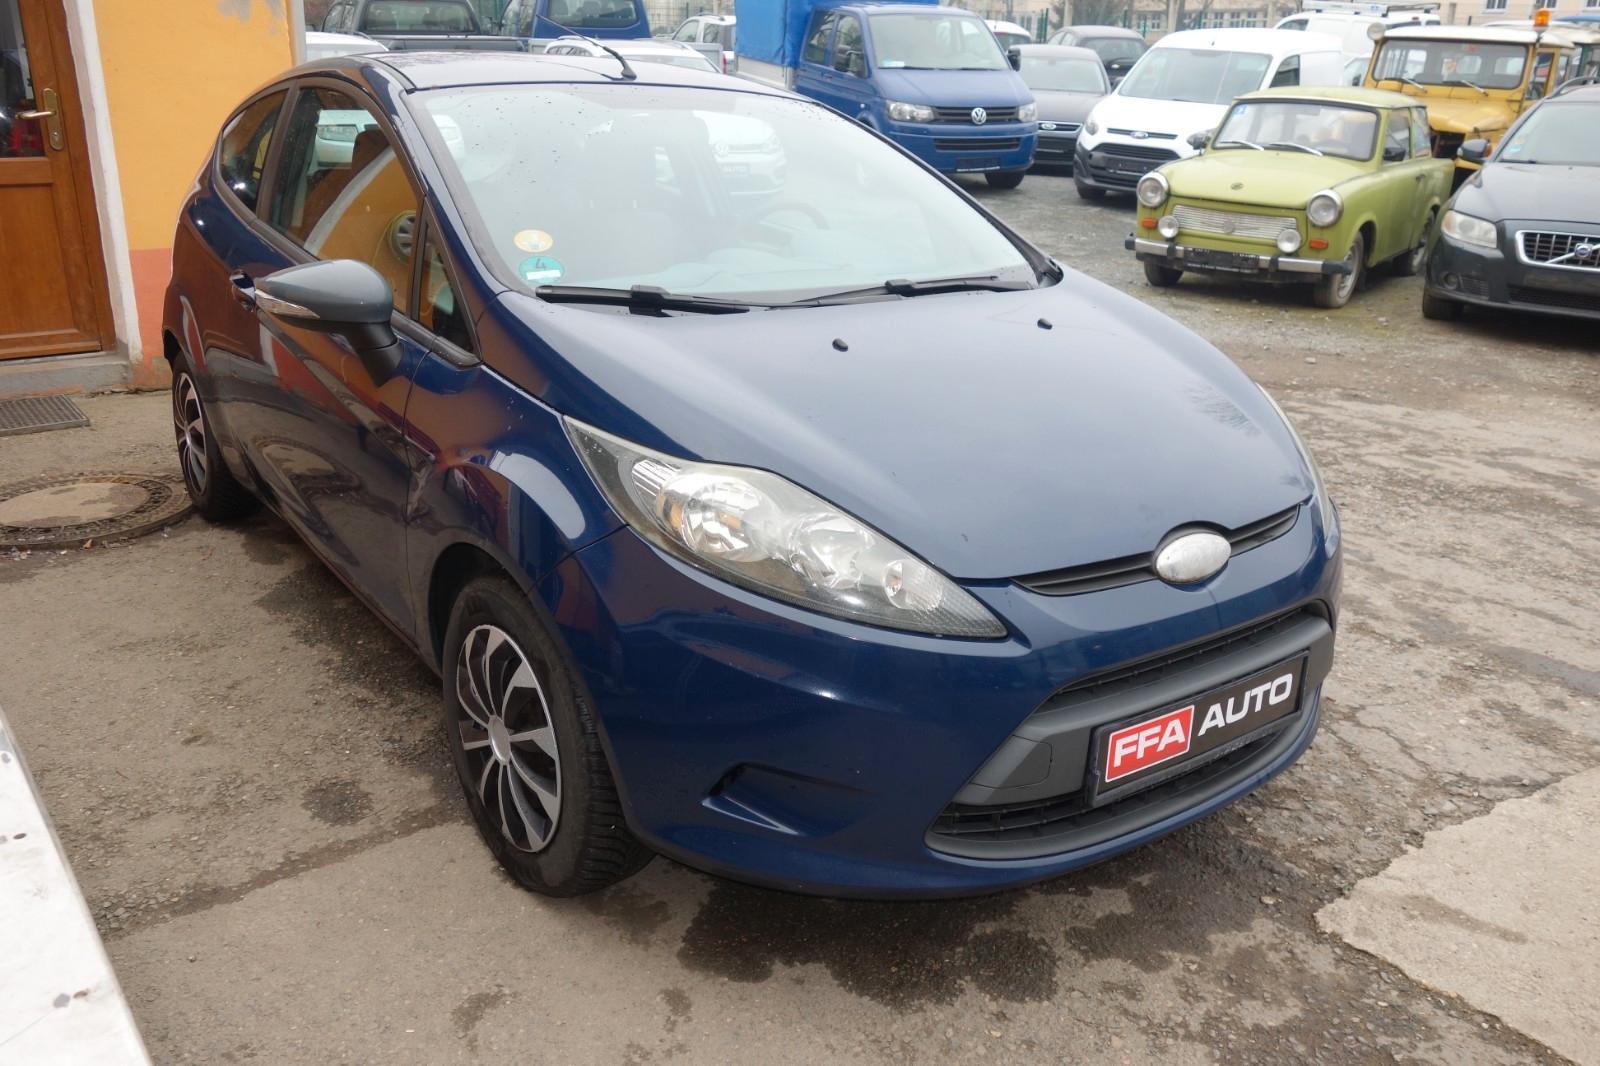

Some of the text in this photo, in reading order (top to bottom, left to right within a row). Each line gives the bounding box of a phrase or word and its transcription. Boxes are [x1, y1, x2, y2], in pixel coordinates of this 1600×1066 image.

[535, 257, 547, 271] 4
[1113, 673, 1293, 768] FFA AUTO
